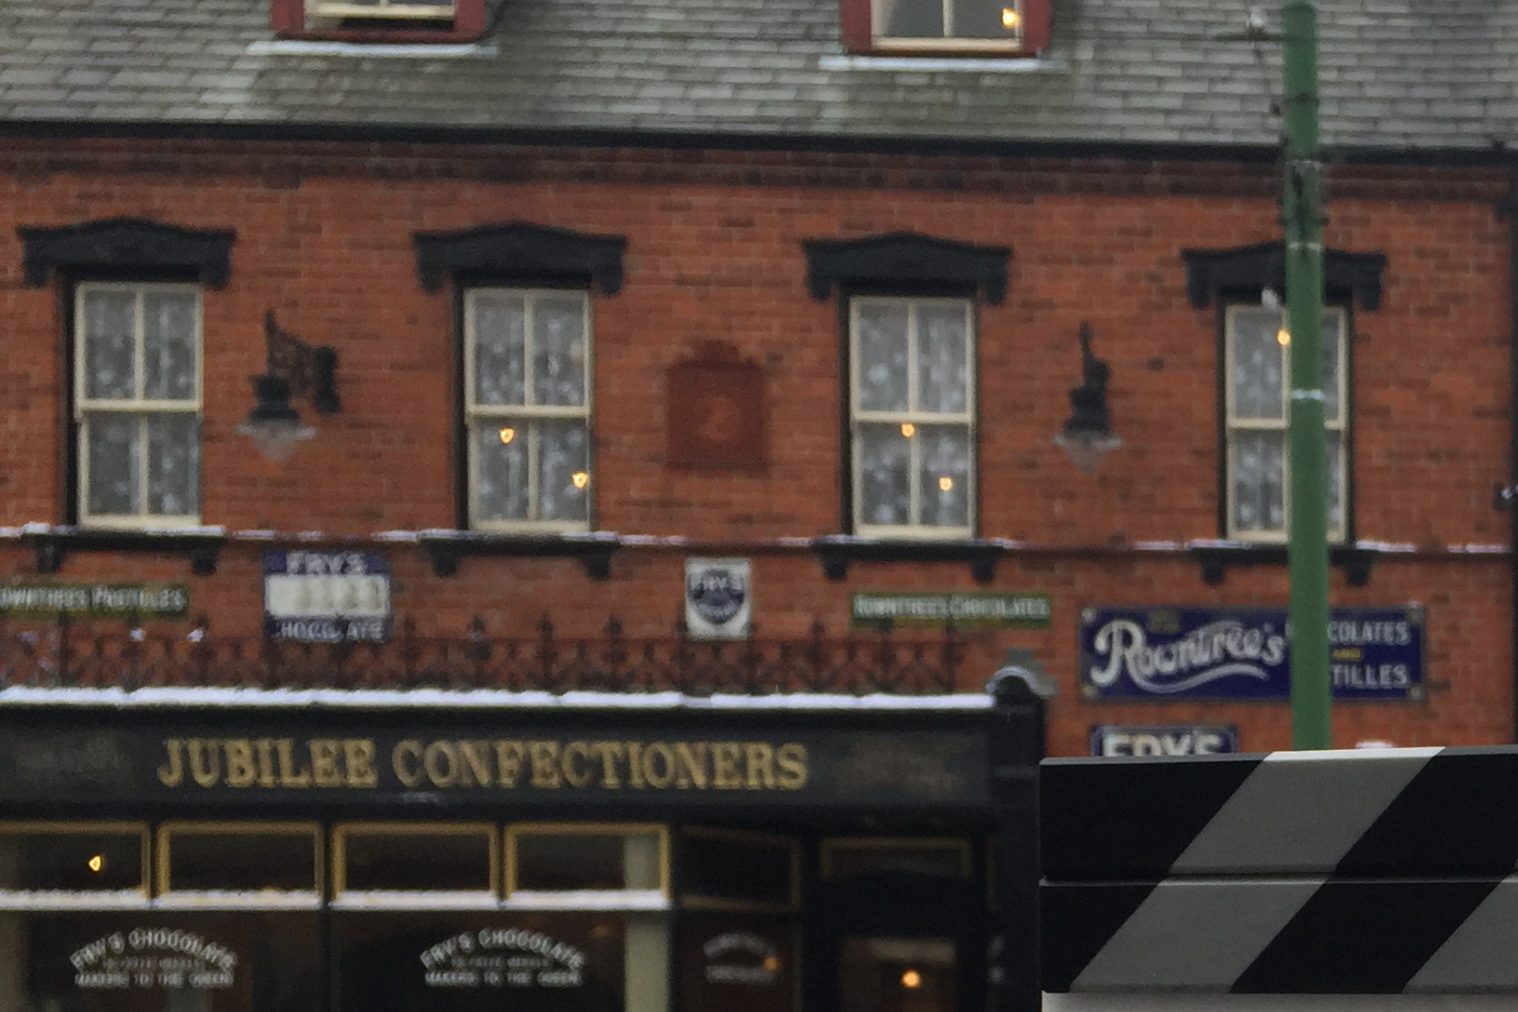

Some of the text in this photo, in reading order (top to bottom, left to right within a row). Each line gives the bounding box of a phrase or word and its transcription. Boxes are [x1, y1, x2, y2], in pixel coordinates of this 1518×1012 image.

[1090, 618, 1285, 694] Rowntree's
[1330, 663, 1409, 688] TILLES
[157, 737, 378, 789] JUBILEE
[391, 738, 808, 791] CONFECTIONERS
